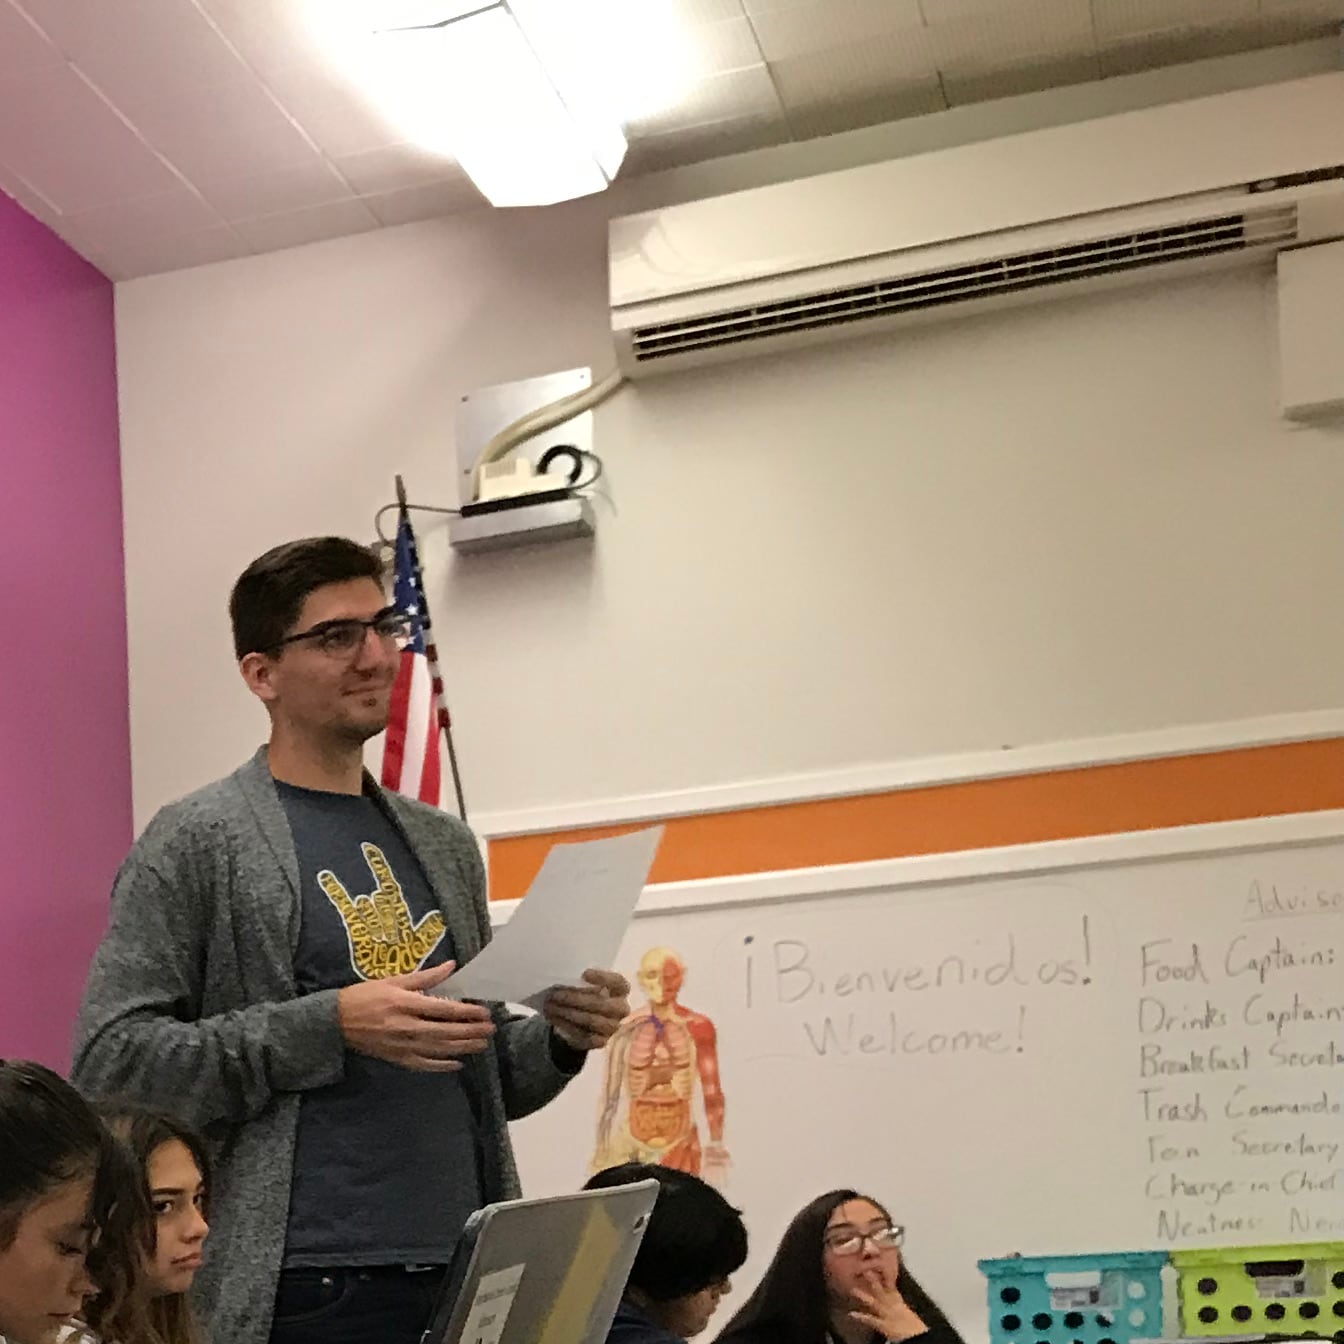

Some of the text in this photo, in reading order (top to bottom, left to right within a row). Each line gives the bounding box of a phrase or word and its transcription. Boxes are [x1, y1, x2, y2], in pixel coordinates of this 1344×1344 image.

[1141, 935, 1335, 987] Food Captain:
[804, 1006, 1026, 1057] Welcome!
[1139, 997, 1227, 1034] Drinks
[1138, 1087, 1208, 1122] Trash
[1232, 1129, 1339, 1163] Secretary
